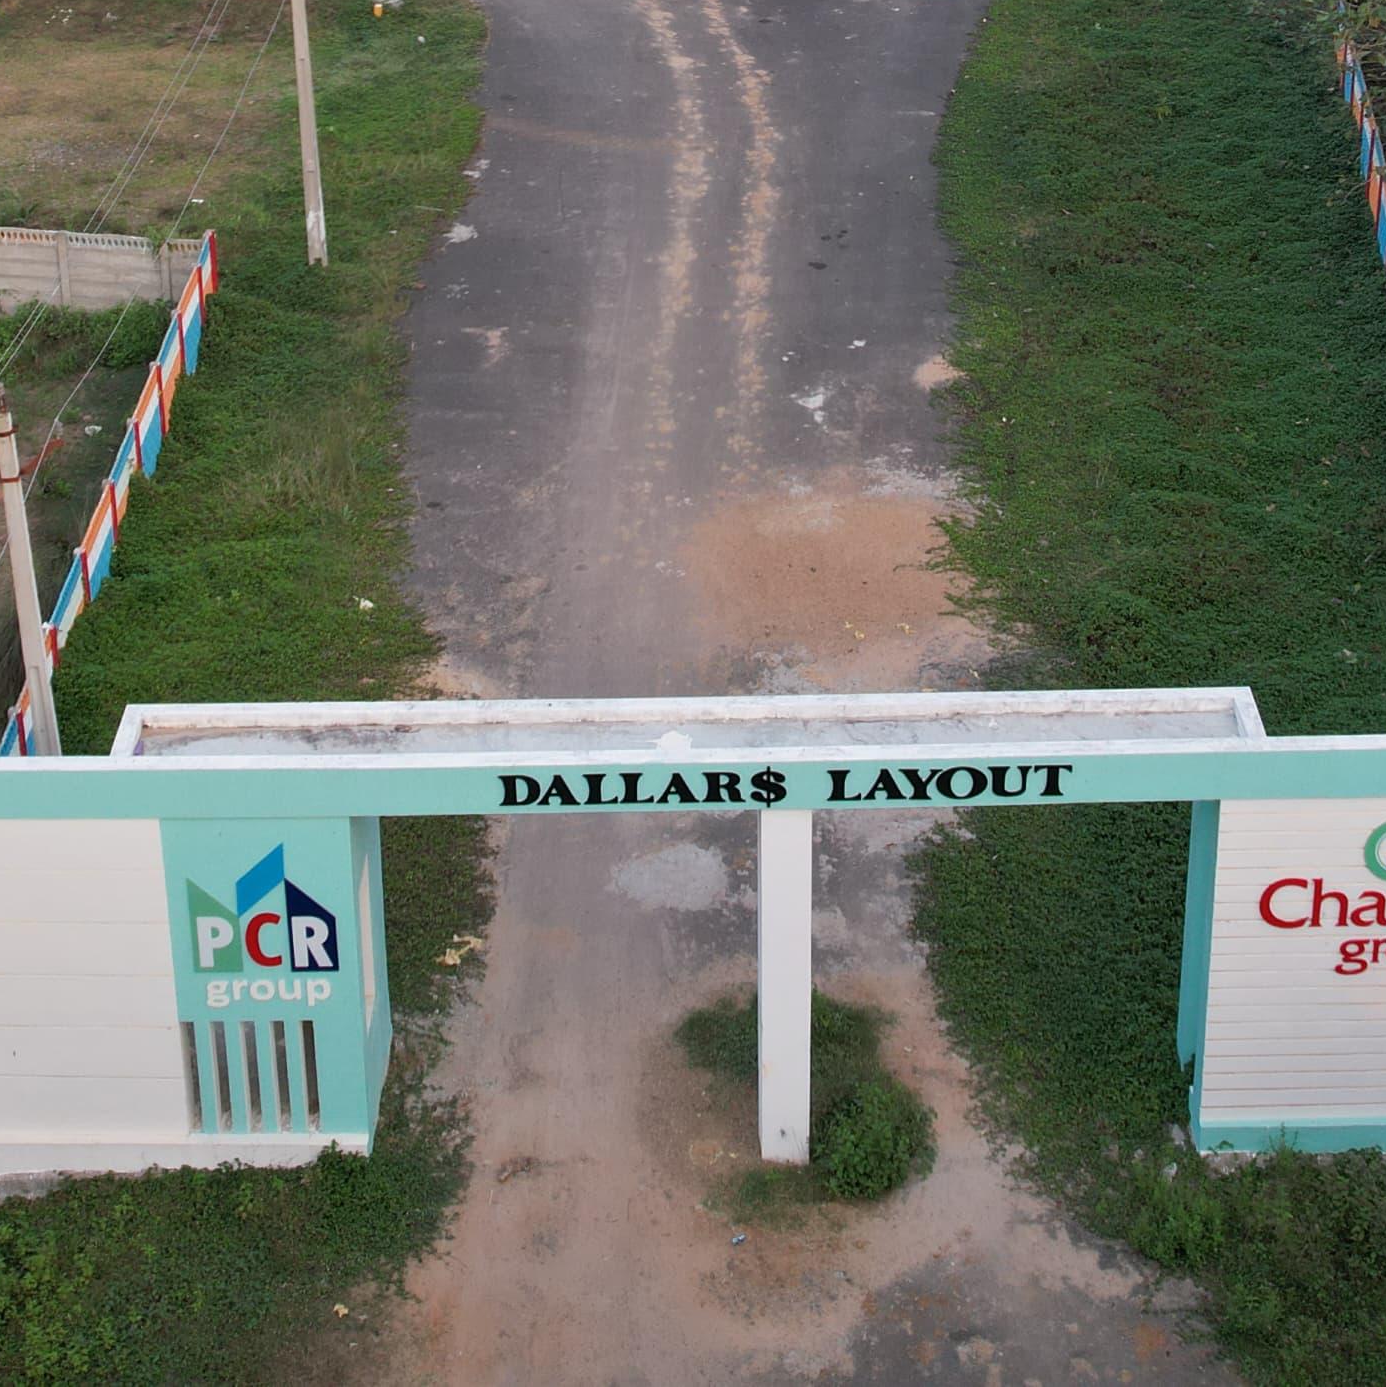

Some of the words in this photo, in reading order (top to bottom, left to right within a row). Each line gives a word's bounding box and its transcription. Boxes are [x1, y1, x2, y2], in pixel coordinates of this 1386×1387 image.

[826, 764, 1073, 801] LAYOUT
[196, 912, 333, 968] PCR
[206, 978, 332, 1008] group
